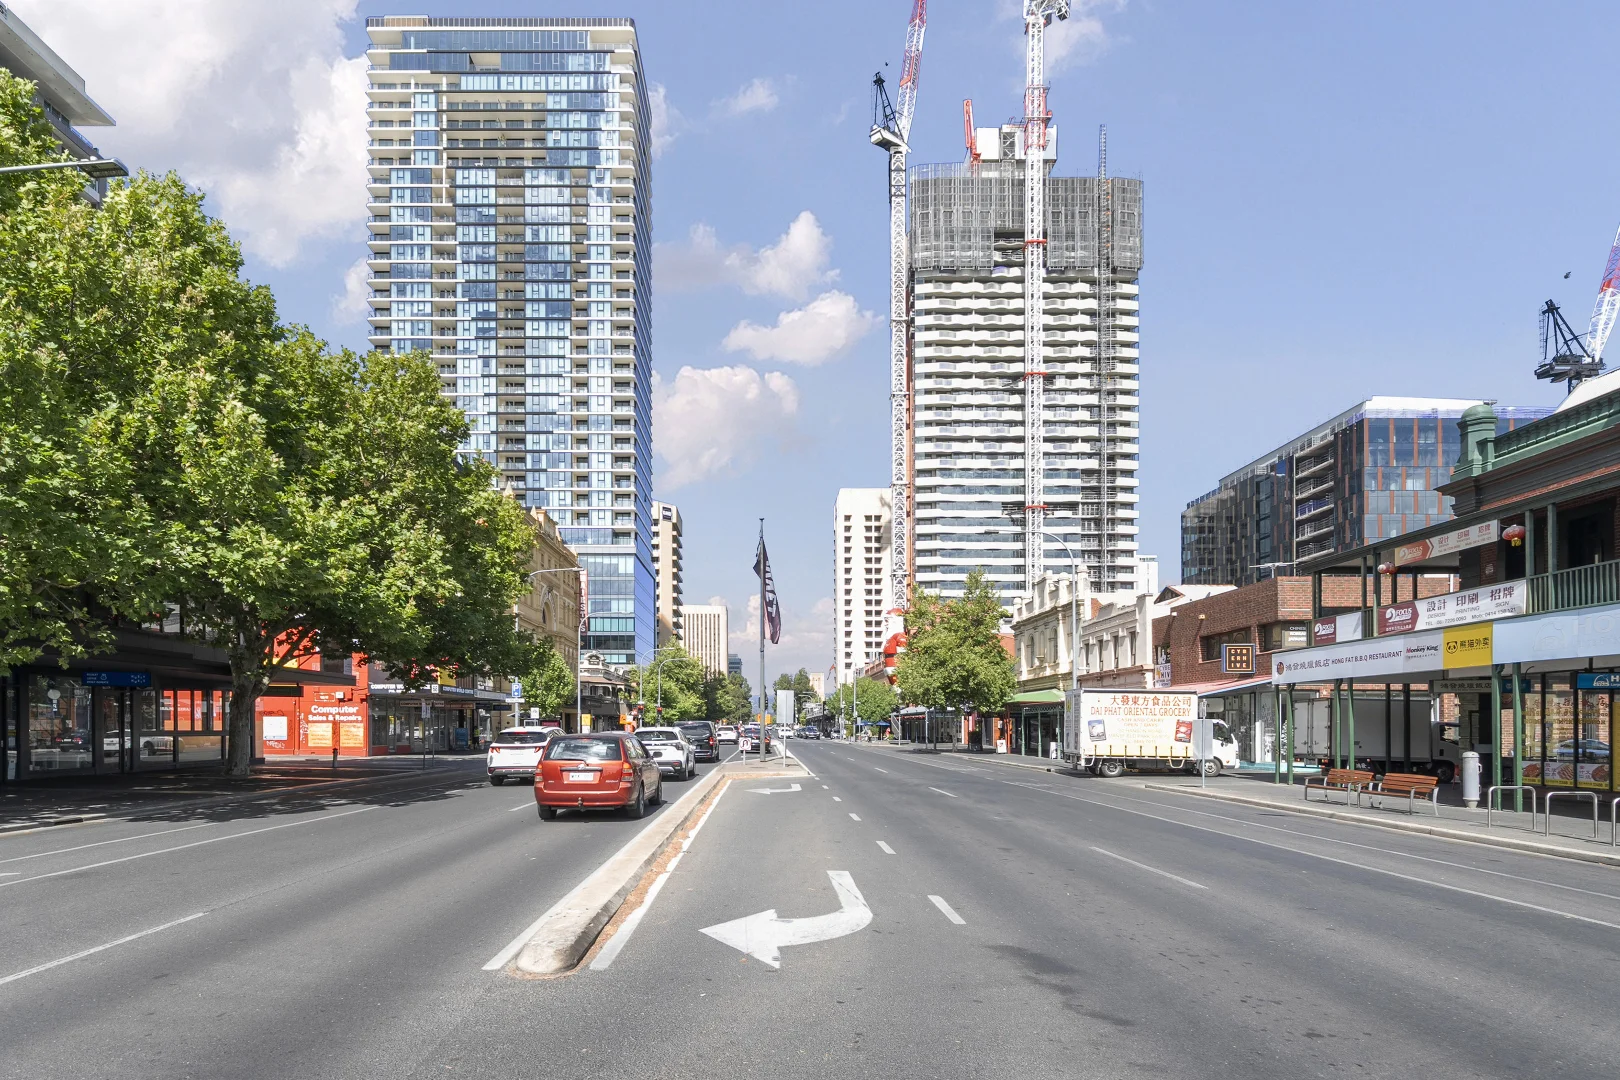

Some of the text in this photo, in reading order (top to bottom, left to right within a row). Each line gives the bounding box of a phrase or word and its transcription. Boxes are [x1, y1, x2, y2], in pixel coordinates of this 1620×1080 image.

[1426, 586, 1514, 612] 設計 印刷 招牌
[1396, 608, 1412, 616] FOCUS
[1455, 606, 1480, 614] PRINTING
[1460, 637, 1490, 648] 熊猫外卖
[1406, 646, 1426, 654] Monkey
[1369, 651, 1402, 660] RESTAURANT
[1111, 695, 1192, 707] 大發東方食品公司
[311, 705, 359, 714] Computer
[1091, 707, 1191, 717] DAI PHAT ORIENTAL GROCERY
